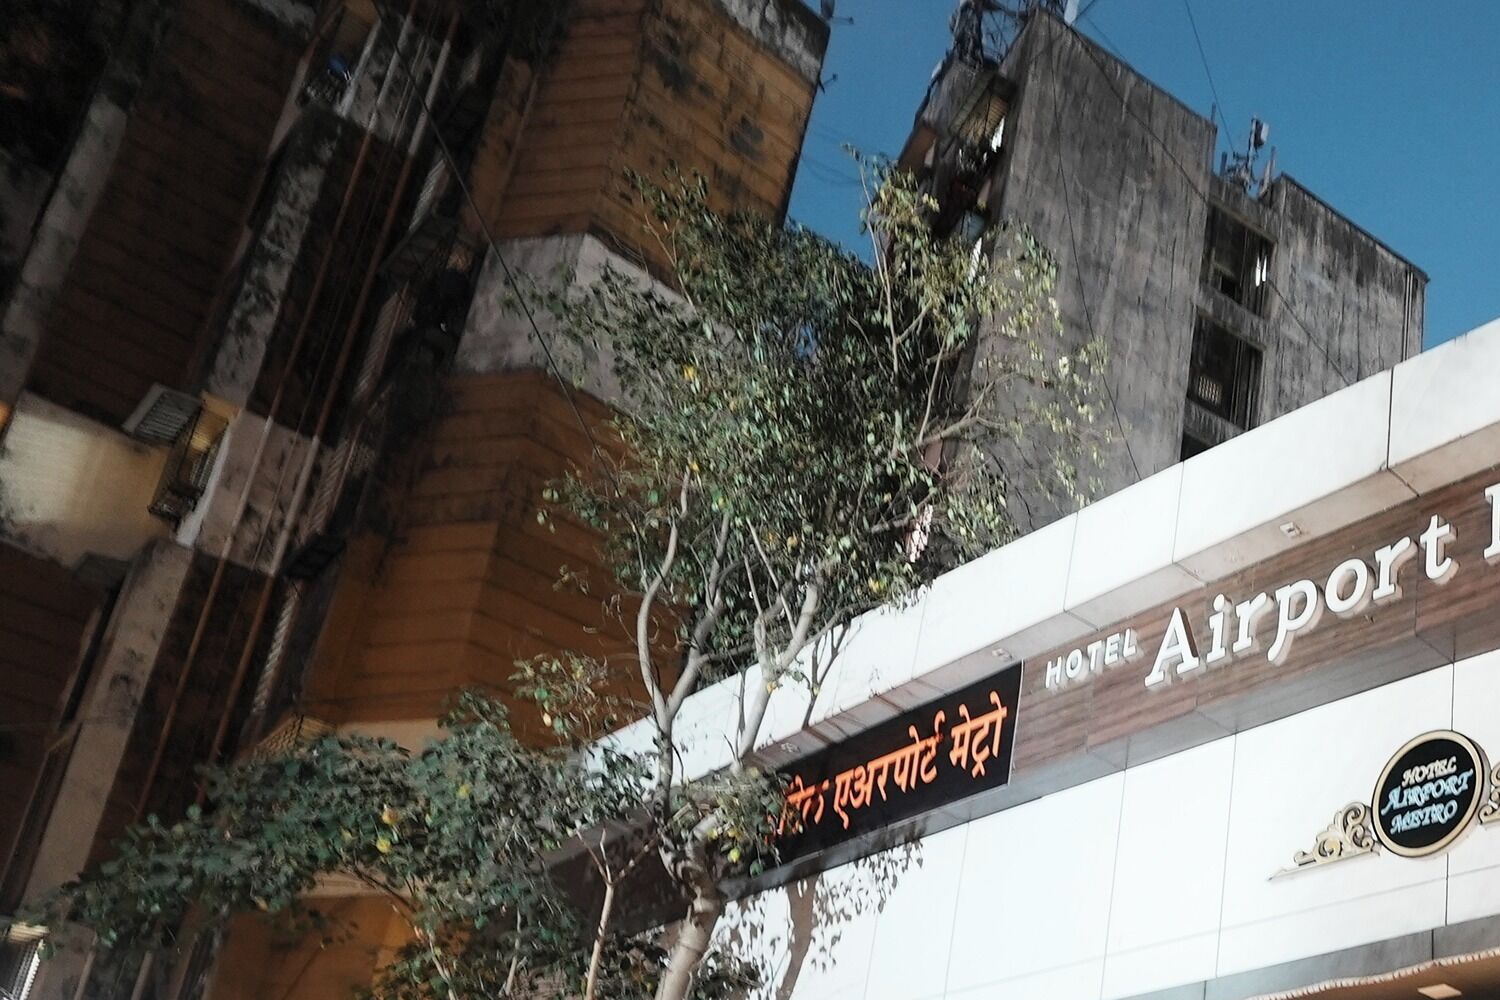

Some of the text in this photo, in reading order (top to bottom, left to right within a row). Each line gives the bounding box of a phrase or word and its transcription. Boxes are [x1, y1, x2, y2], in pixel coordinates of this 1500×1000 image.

[1045, 628, 1138, 690] HOTEL
[1143, 512, 1458, 690] Airport
[833, 709, 946, 830] एअरपोर्ट
[948, 690, 1009, 780] मेट्रो
[1402, 756, 1458, 787] HOTEL
[1381, 768, 1474, 816] AIRPORT
[1390, 799, 1458, 835] METRO
